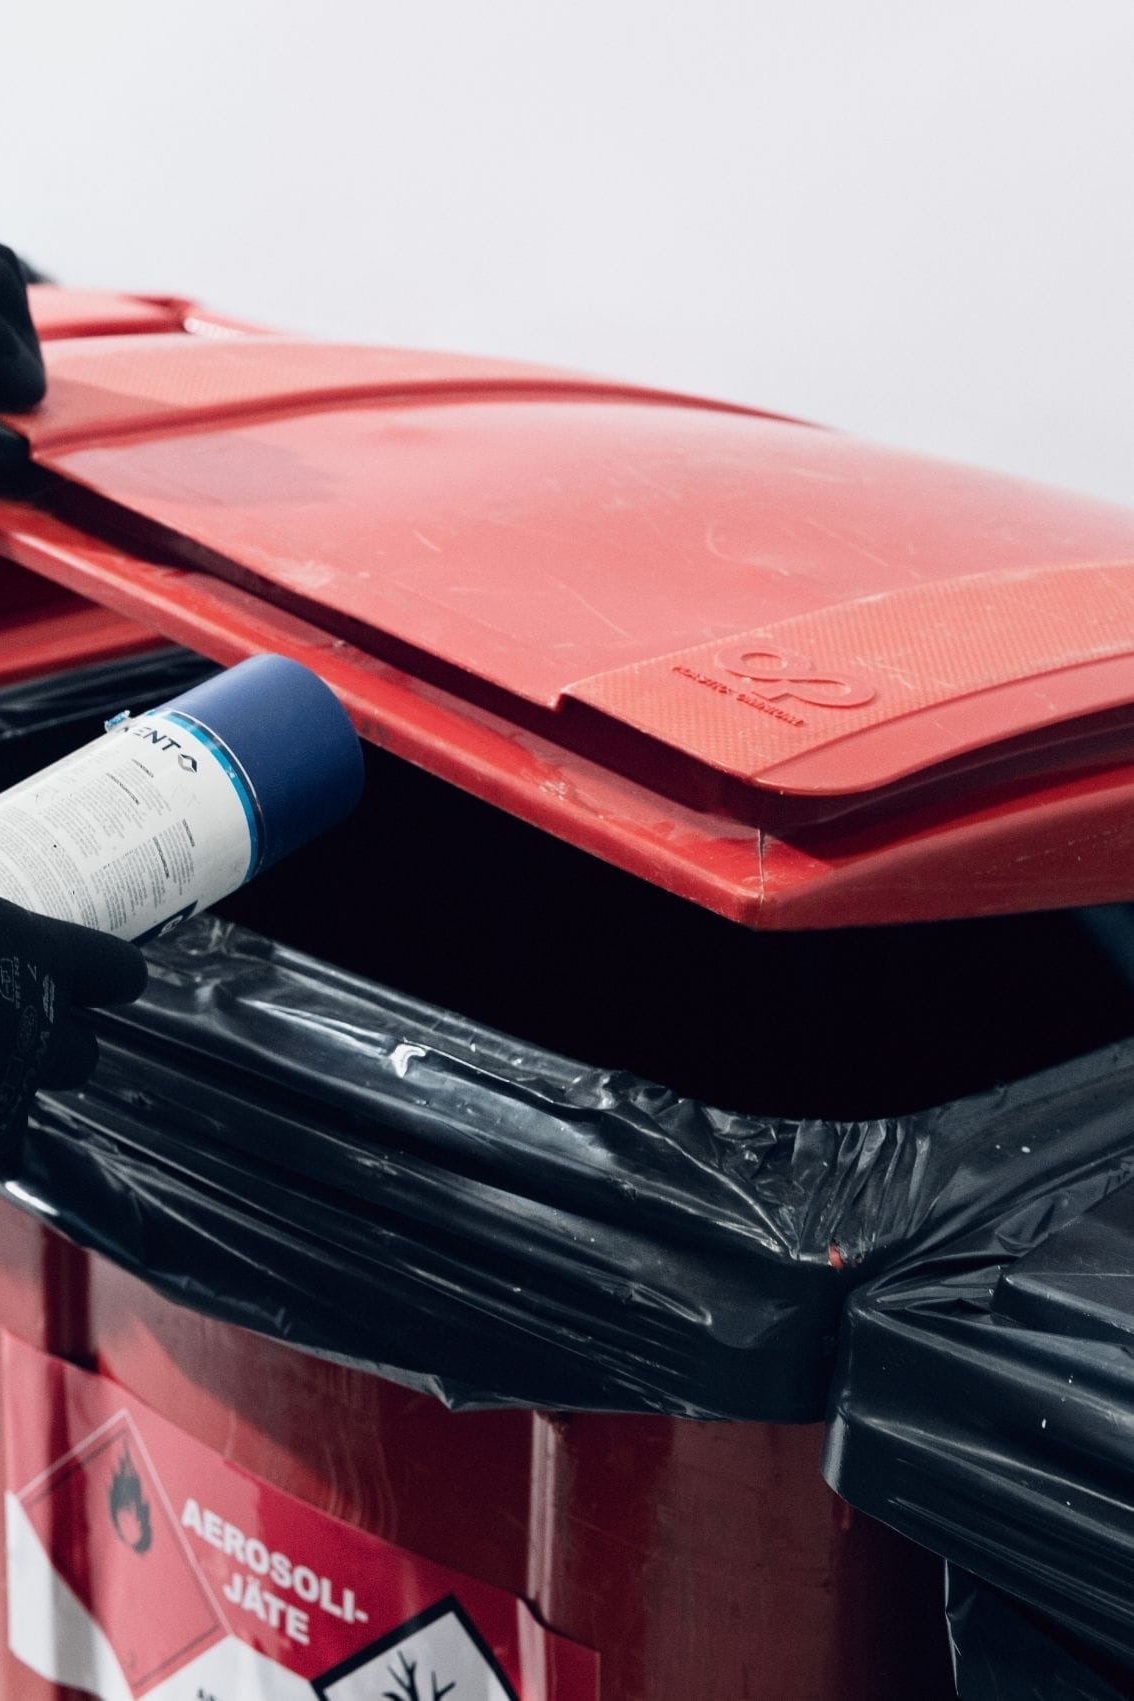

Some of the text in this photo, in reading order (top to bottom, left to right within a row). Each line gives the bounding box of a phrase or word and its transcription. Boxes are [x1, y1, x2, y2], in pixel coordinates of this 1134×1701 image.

[117, 725, 182, 751] ENT
[180, 1498, 369, 1624] AEROSOLI-
[222, 1573, 311, 1646] JÄTE
